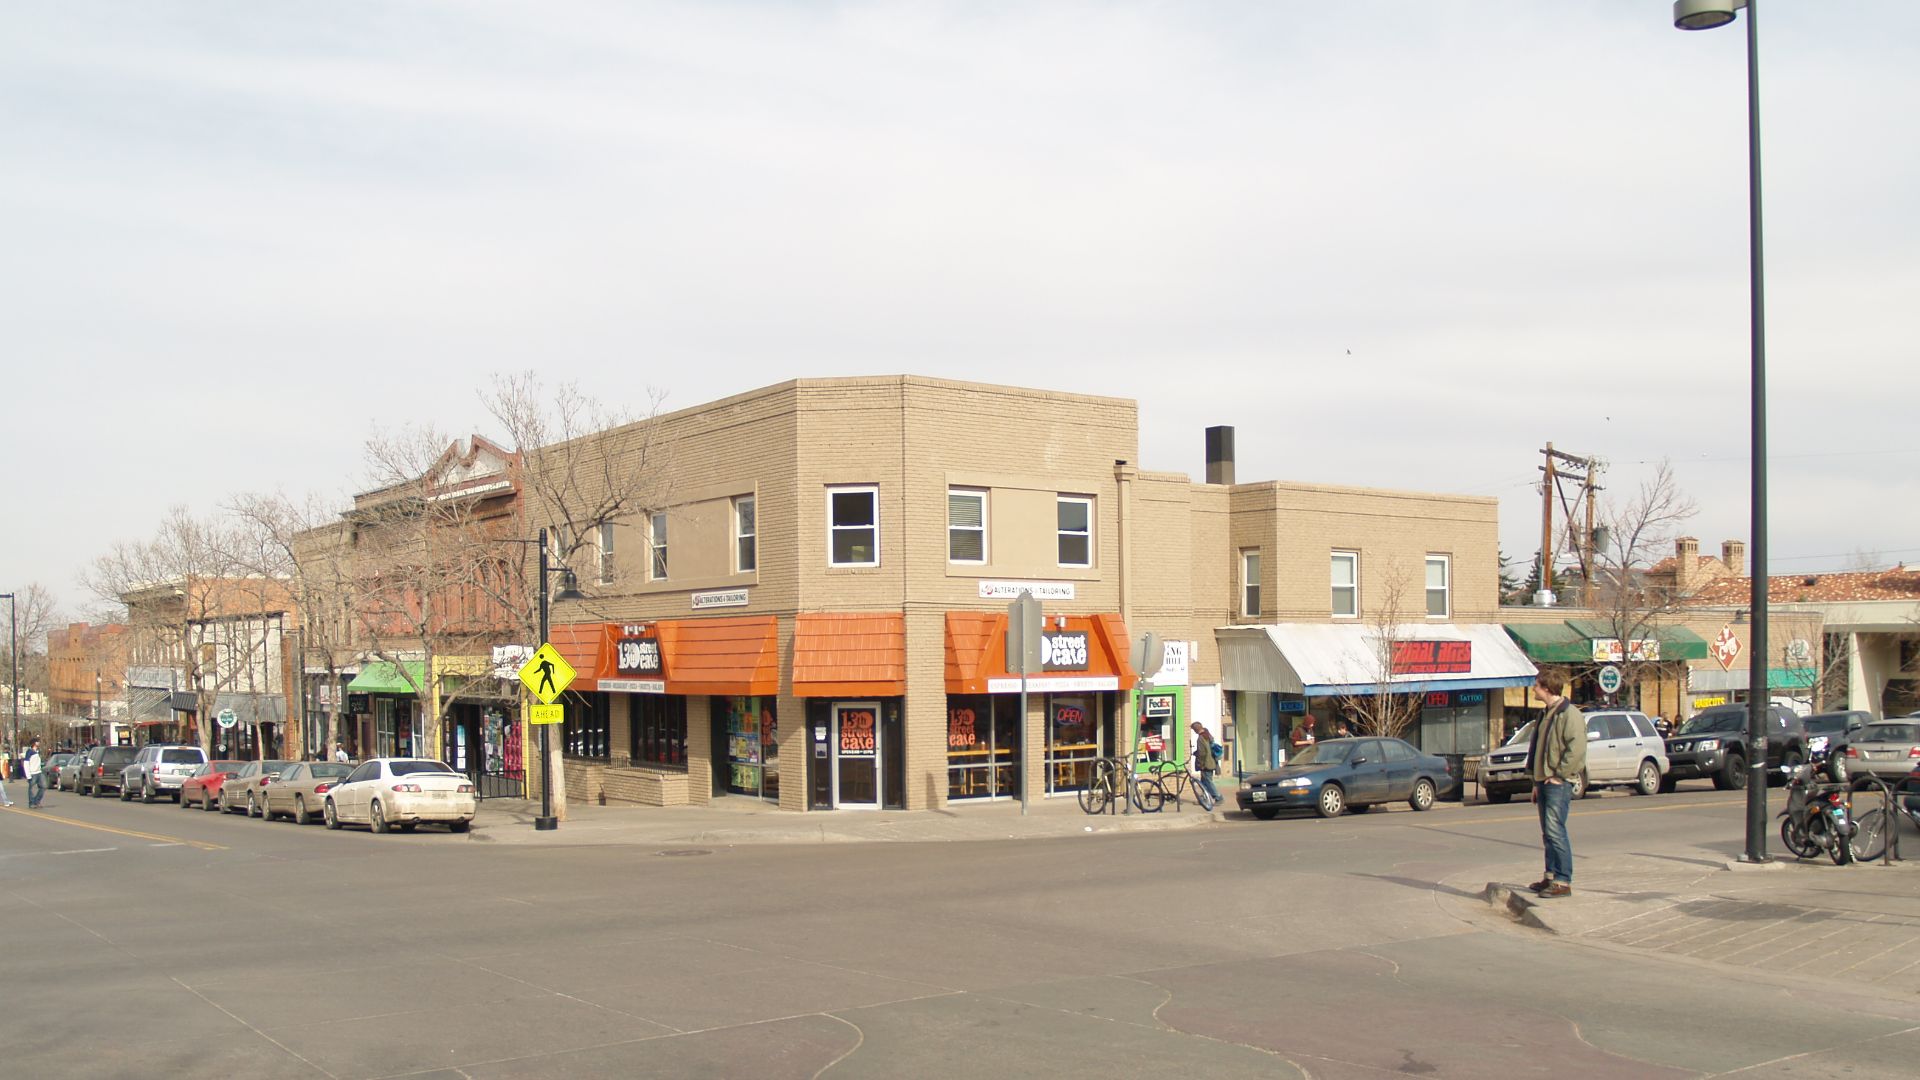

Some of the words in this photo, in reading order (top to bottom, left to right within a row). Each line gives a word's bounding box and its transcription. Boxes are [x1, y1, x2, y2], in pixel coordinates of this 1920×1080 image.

[994, 586, 1033, 595] ALTERATIONS
[1039, 587, 1071, 595] TAILORING
[1051, 634, 1086, 649] street
[1148, 698, 1170, 708] FedEx
[1460, 694, 1482, 703] TATTOO
[535, 710, 560, 719] AHEAD
[1058, 708, 1083, 722] OPEN
[841, 728, 873, 738] street
[841, 737, 874, 750] cafe
